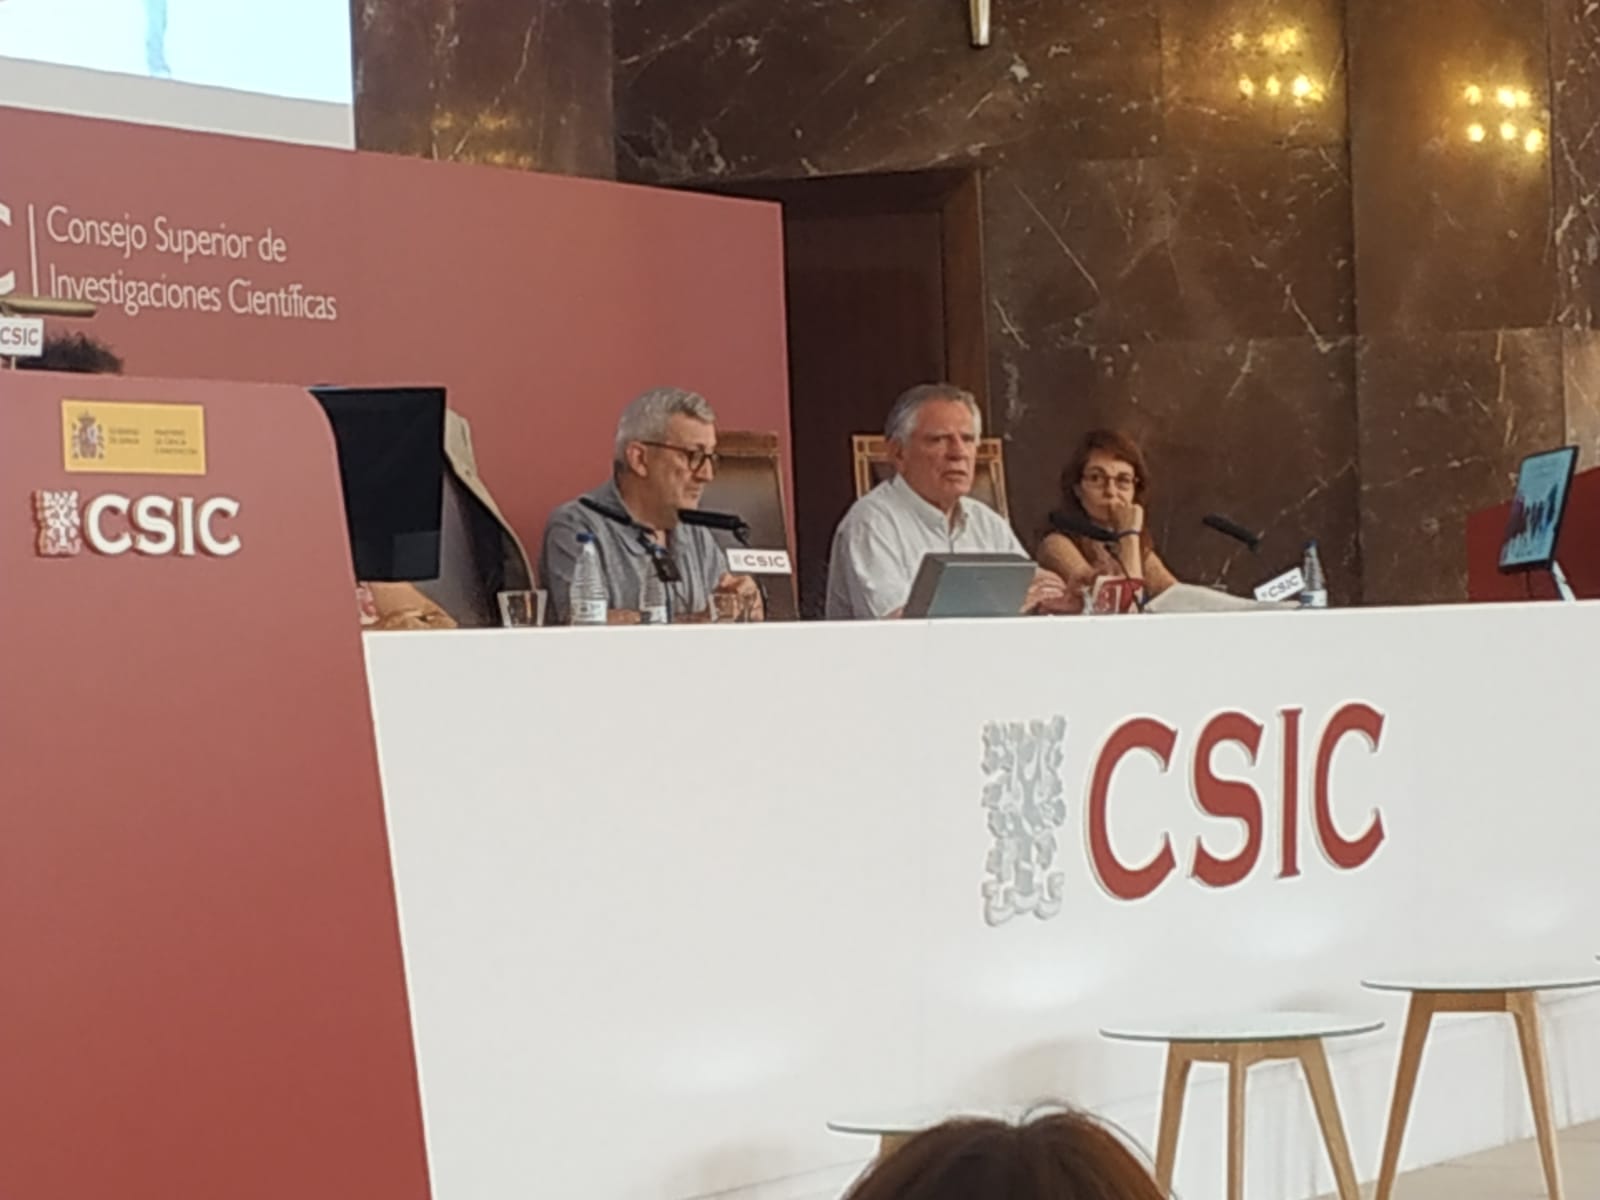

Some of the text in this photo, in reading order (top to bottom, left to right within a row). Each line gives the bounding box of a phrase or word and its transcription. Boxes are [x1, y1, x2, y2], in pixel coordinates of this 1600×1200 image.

[47, 205, 147, 259] Consejo
[154, 216, 252, 264] Superior
[258, 227, 287, 262] de
[50, 263, 337, 320] Investigaciones Científicas
[0, 326, 39, 346] CSIC
[84, 493, 241, 556] CSIC
[743, 554, 786, 568] CSIC
[1268, 575, 1299, 598] CSIC
[1084, 702, 1386, 901] CSIC
